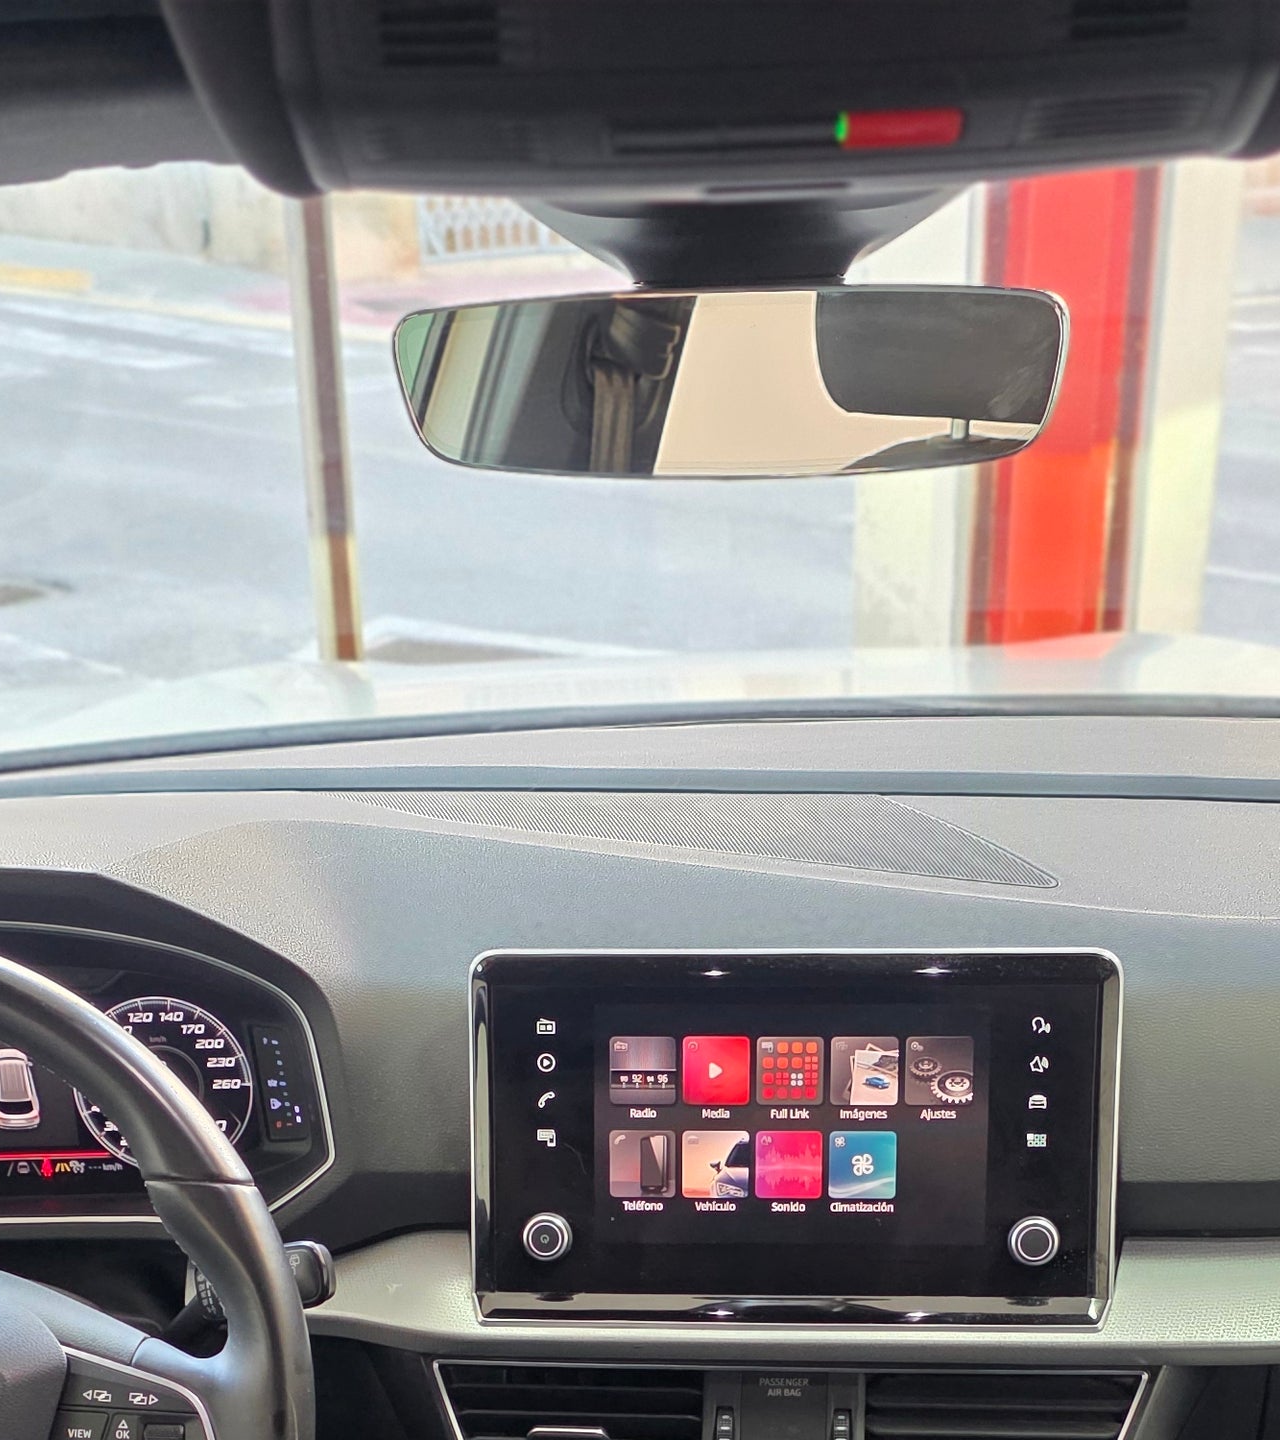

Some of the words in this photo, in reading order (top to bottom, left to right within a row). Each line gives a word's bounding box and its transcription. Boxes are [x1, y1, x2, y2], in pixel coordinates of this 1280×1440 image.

[127, 1012, 153, 1022] 120
[159, 1011, 184, 1022] 140
[181, 1024, 205, 1035] 170
[195, 1039, 224, 1049] 200
[206, 1057, 236, 1067] 230
[632, 1073, 642, 1083] 92
[657, 1073, 668, 1083] 96
[212, 1079, 241, 1090] 260
[630, 1108, 657, 1118] Radio
[702, 1109, 730, 1119] Media
[770, 1109, 787, 1119] Full
[790, 1109, 810, 1119] Link
[840, 1109, 888, 1121] Imágenes
[920, 1109, 957, 1120] Ajustes
[622, 1200, 664, 1211] Teléfono
[695, 1201, 737, 1212] Vehículo
[771, 1202, 806, 1212] Sonido
[830, 1202, 894, 1212] Climatización
[759, 1377, 809, 1387] PASSENGER
[767, 1388, 782, 1397] AIR
[783, 1388, 802, 1397] BAG
[67, 1428, 92, 1439] VIEW
[115, 1430, 130, 1440] OK
